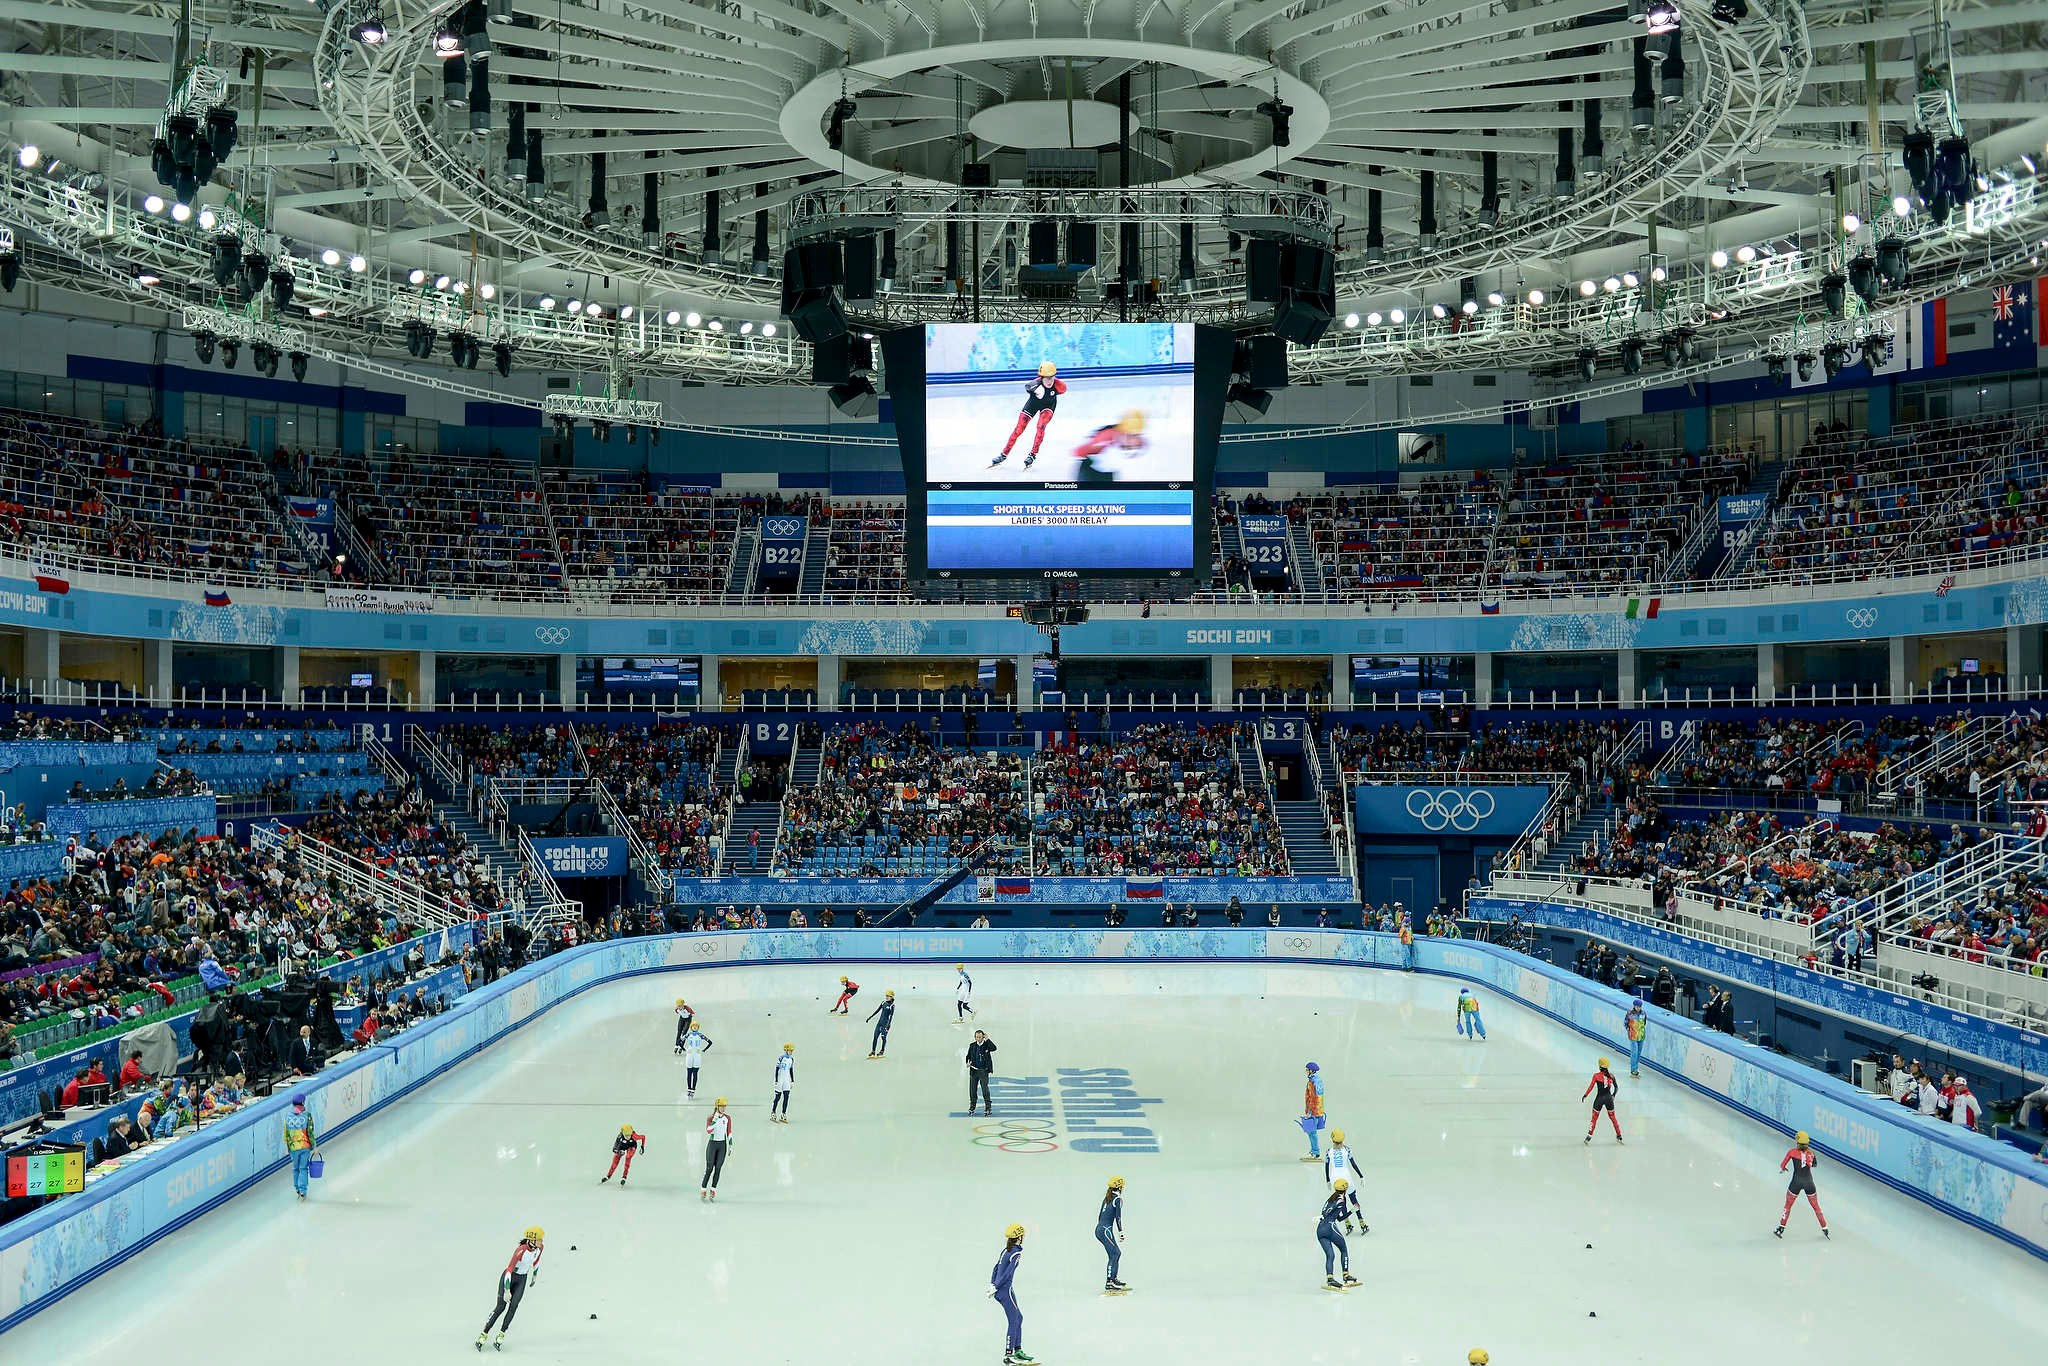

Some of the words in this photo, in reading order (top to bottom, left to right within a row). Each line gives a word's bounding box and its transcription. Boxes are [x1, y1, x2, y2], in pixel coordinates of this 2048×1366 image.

[993, 505, 1024, 514] SHORT
[1024, 505, 1055, 514] TRACK
[1056, 505, 1085, 514] SPEED
[1086, 505, 1126, 514] SKATING
[1727, 499, 1761, 508] sochi.ru
[1011, 516, 1045, 525] LADIES'
[1046, 516, 1068, 525] 3000
[1069, 516, 1078, 525] M
[1080, 516, 1108, 525] RELAY
[1245, 519, 1280, 527] sochi.ru
[765, 547, 801, 564] B22
[1246, 545, 1283, 562] B23
[1052, 570, 1079, 578] OMEGA
[25, 594, 46, 614] 2014
[354, 593, 368, 602] GO
[1187, 629, 1232, 643] SOCHI
[1236, 629, 1271, 643] 2014
[545, 845, 609, 860] sochi.ru
[553, 859, 586, 873] 2014
[929, 937, 964, 953] 2014
[1814, 1104, 1847, 1142] SOCHI
[1850, 1121, 1880, 1159] 2014
[33, 1162, 40, 1170] 2
[51, 1160, 58, 1168] 3
[11, 1183, 23, 1191] 27
[30, 1181, 42, 1189] 27
[48, 1179, 60, 1188] 27
[67, 1178, 79, 1186] 27
[167, 1160, 205, 1208] SOCHI
[207, 1147, 237, 1188] 2014
